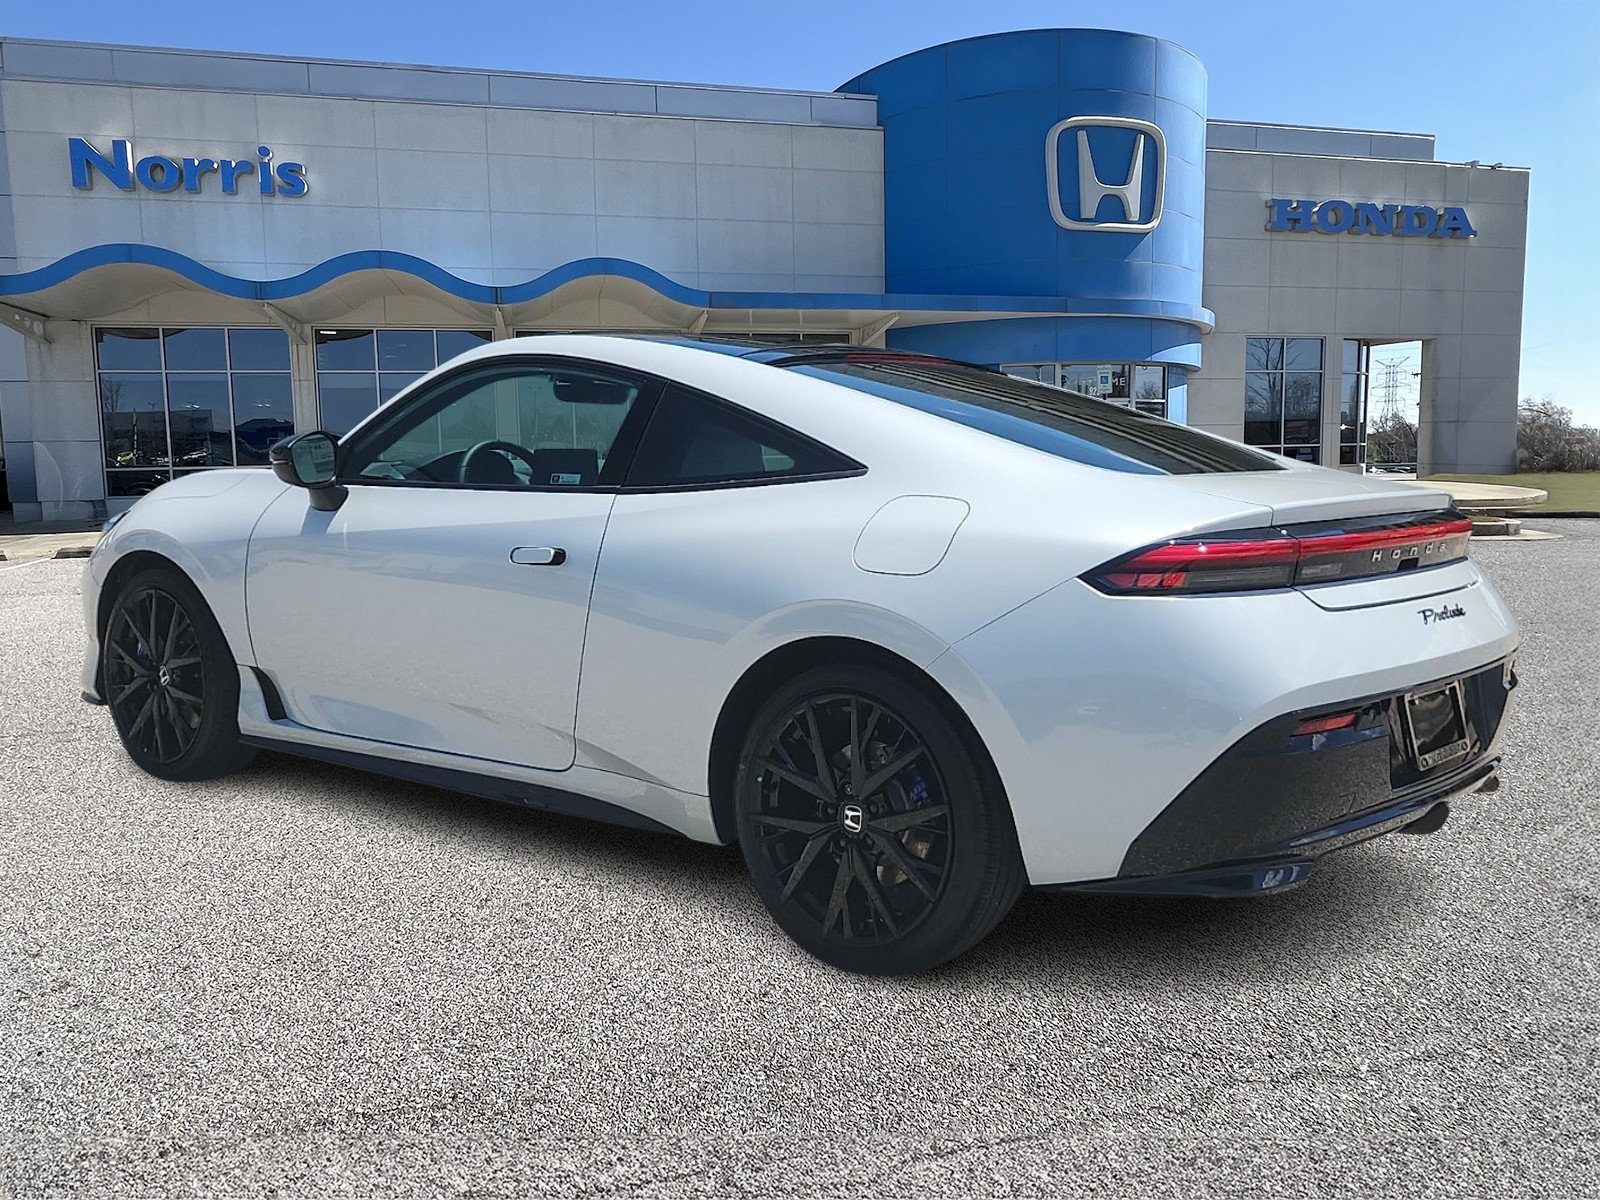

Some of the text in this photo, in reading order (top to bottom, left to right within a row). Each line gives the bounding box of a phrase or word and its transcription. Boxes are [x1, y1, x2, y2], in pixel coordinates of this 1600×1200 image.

[68, 137, 308, 198] Norris
[1265, 198, 1478, 239] HONDA
[1371, 542, 1448, 563] Honda
[1416, 603, 1467, 625] Prelude
